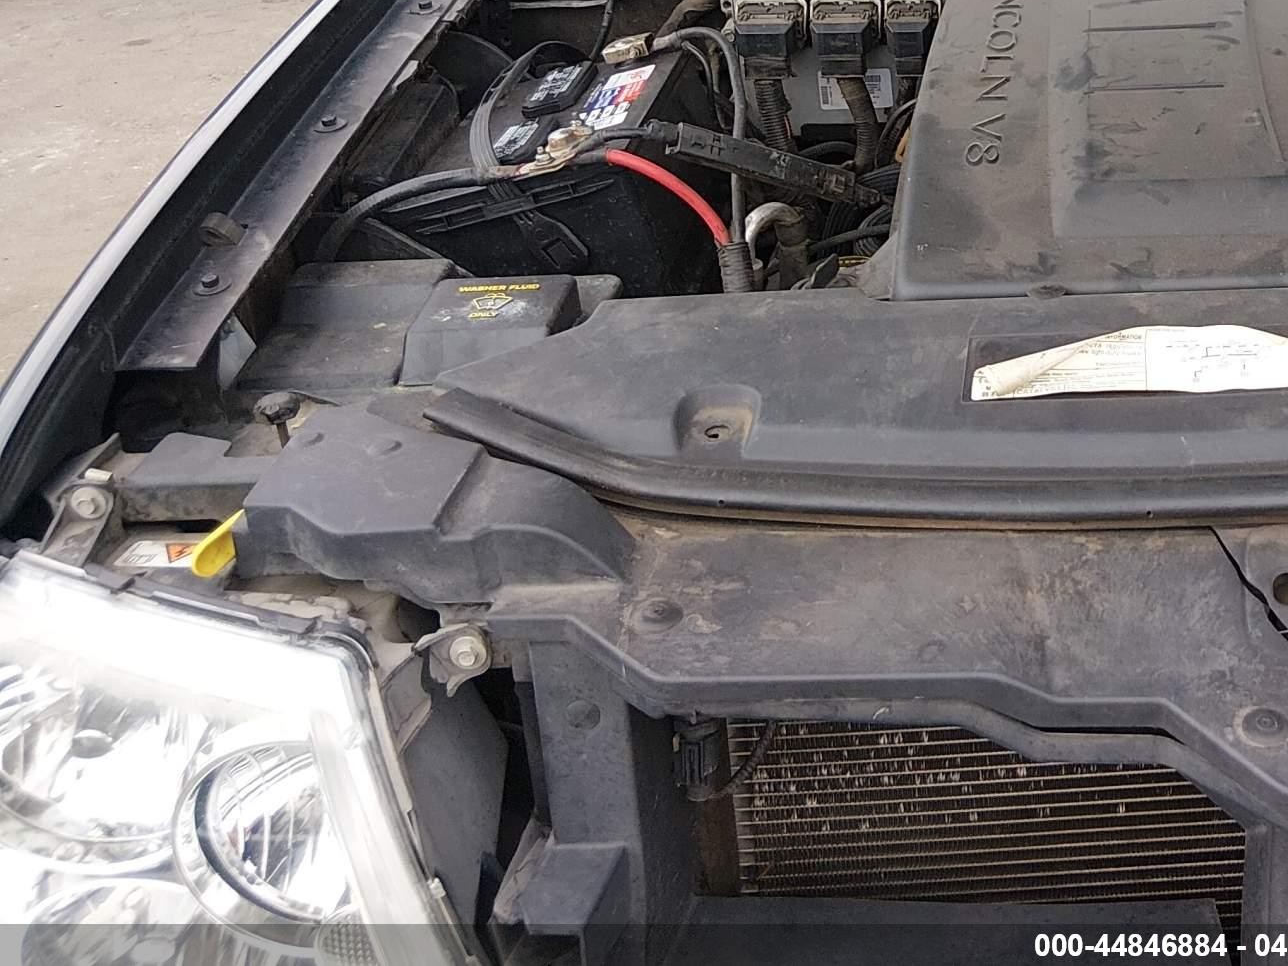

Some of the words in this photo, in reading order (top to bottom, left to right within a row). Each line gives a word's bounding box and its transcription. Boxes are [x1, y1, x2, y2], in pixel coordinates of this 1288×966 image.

[964, 113, 1007, 167] V8
[458, 284, 507, 292] WASHER
[508, 282, 540, 291] FLUID
